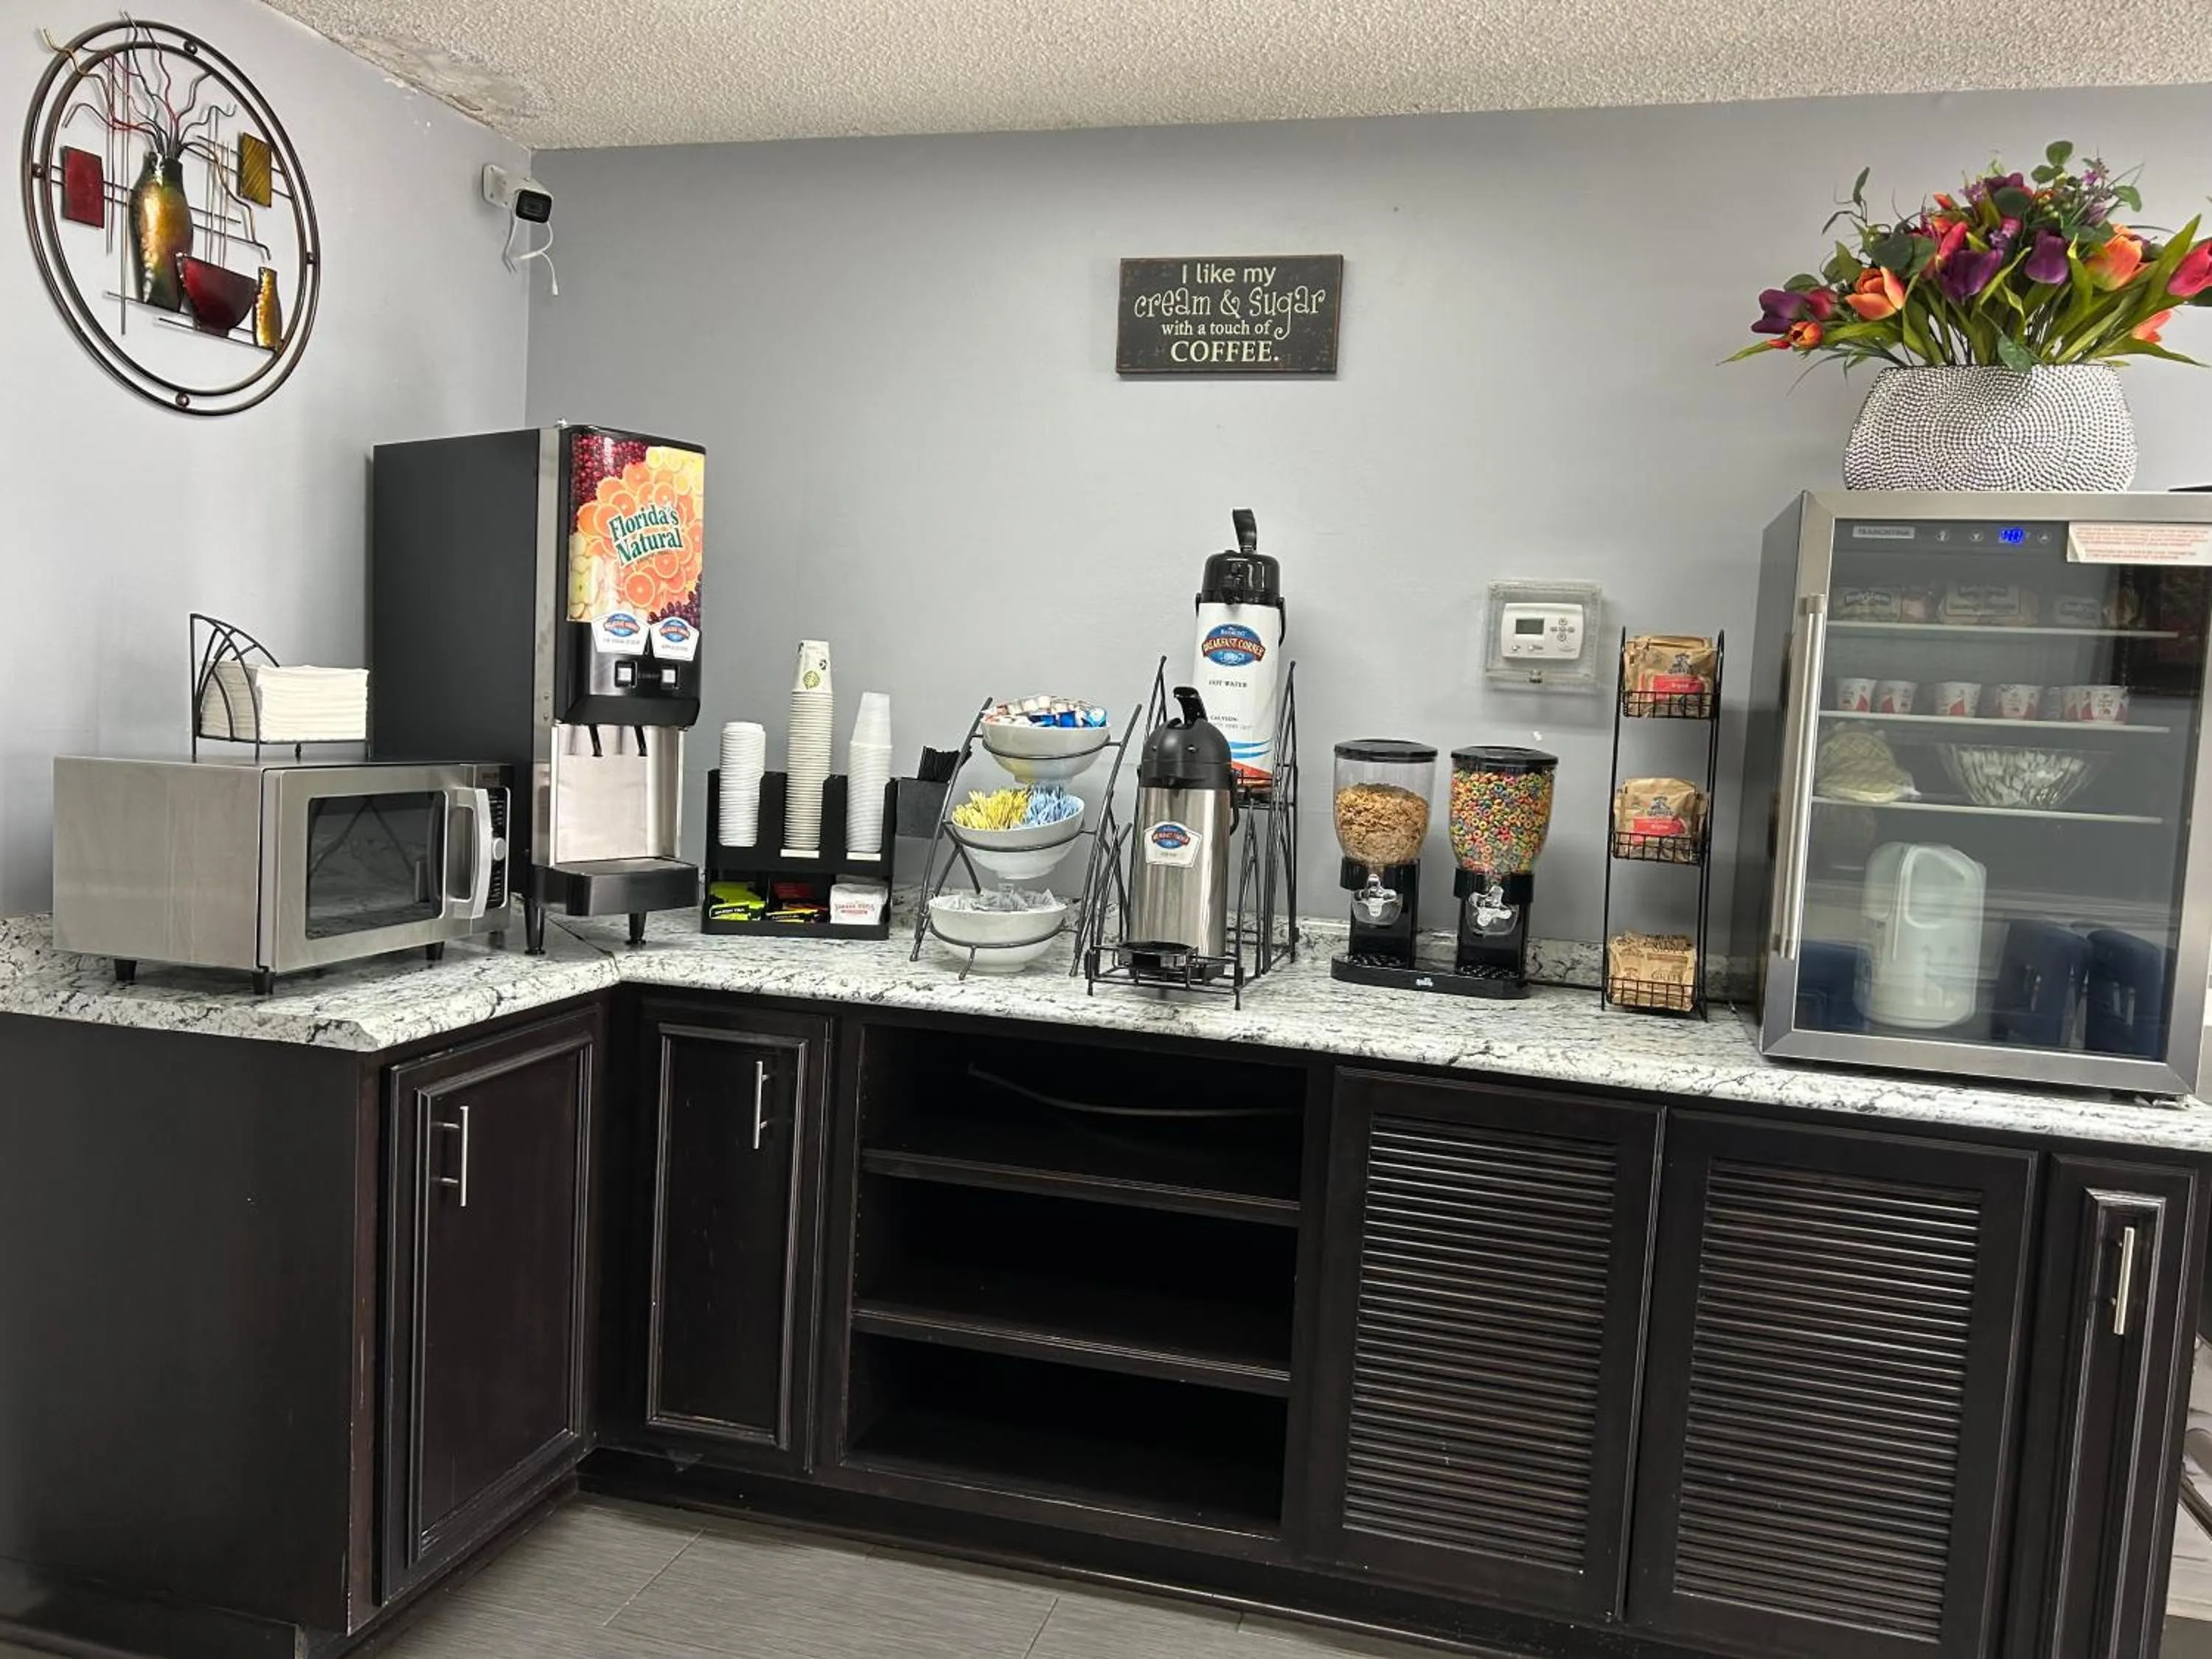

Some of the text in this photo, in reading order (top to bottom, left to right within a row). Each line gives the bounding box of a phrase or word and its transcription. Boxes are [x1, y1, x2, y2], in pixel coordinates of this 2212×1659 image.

[1181, 262, 1278, 288] I like my
[1134, 287, 1211, 319] cream
[1220, 288, 1242, 319] &
[1161, 319, 1273, 336] with a touch of
[1170, 340, 1281, 364] COFFEE.
[608, 504, 680, 543] Florida's
[615, 526, 684, 567] Natural
